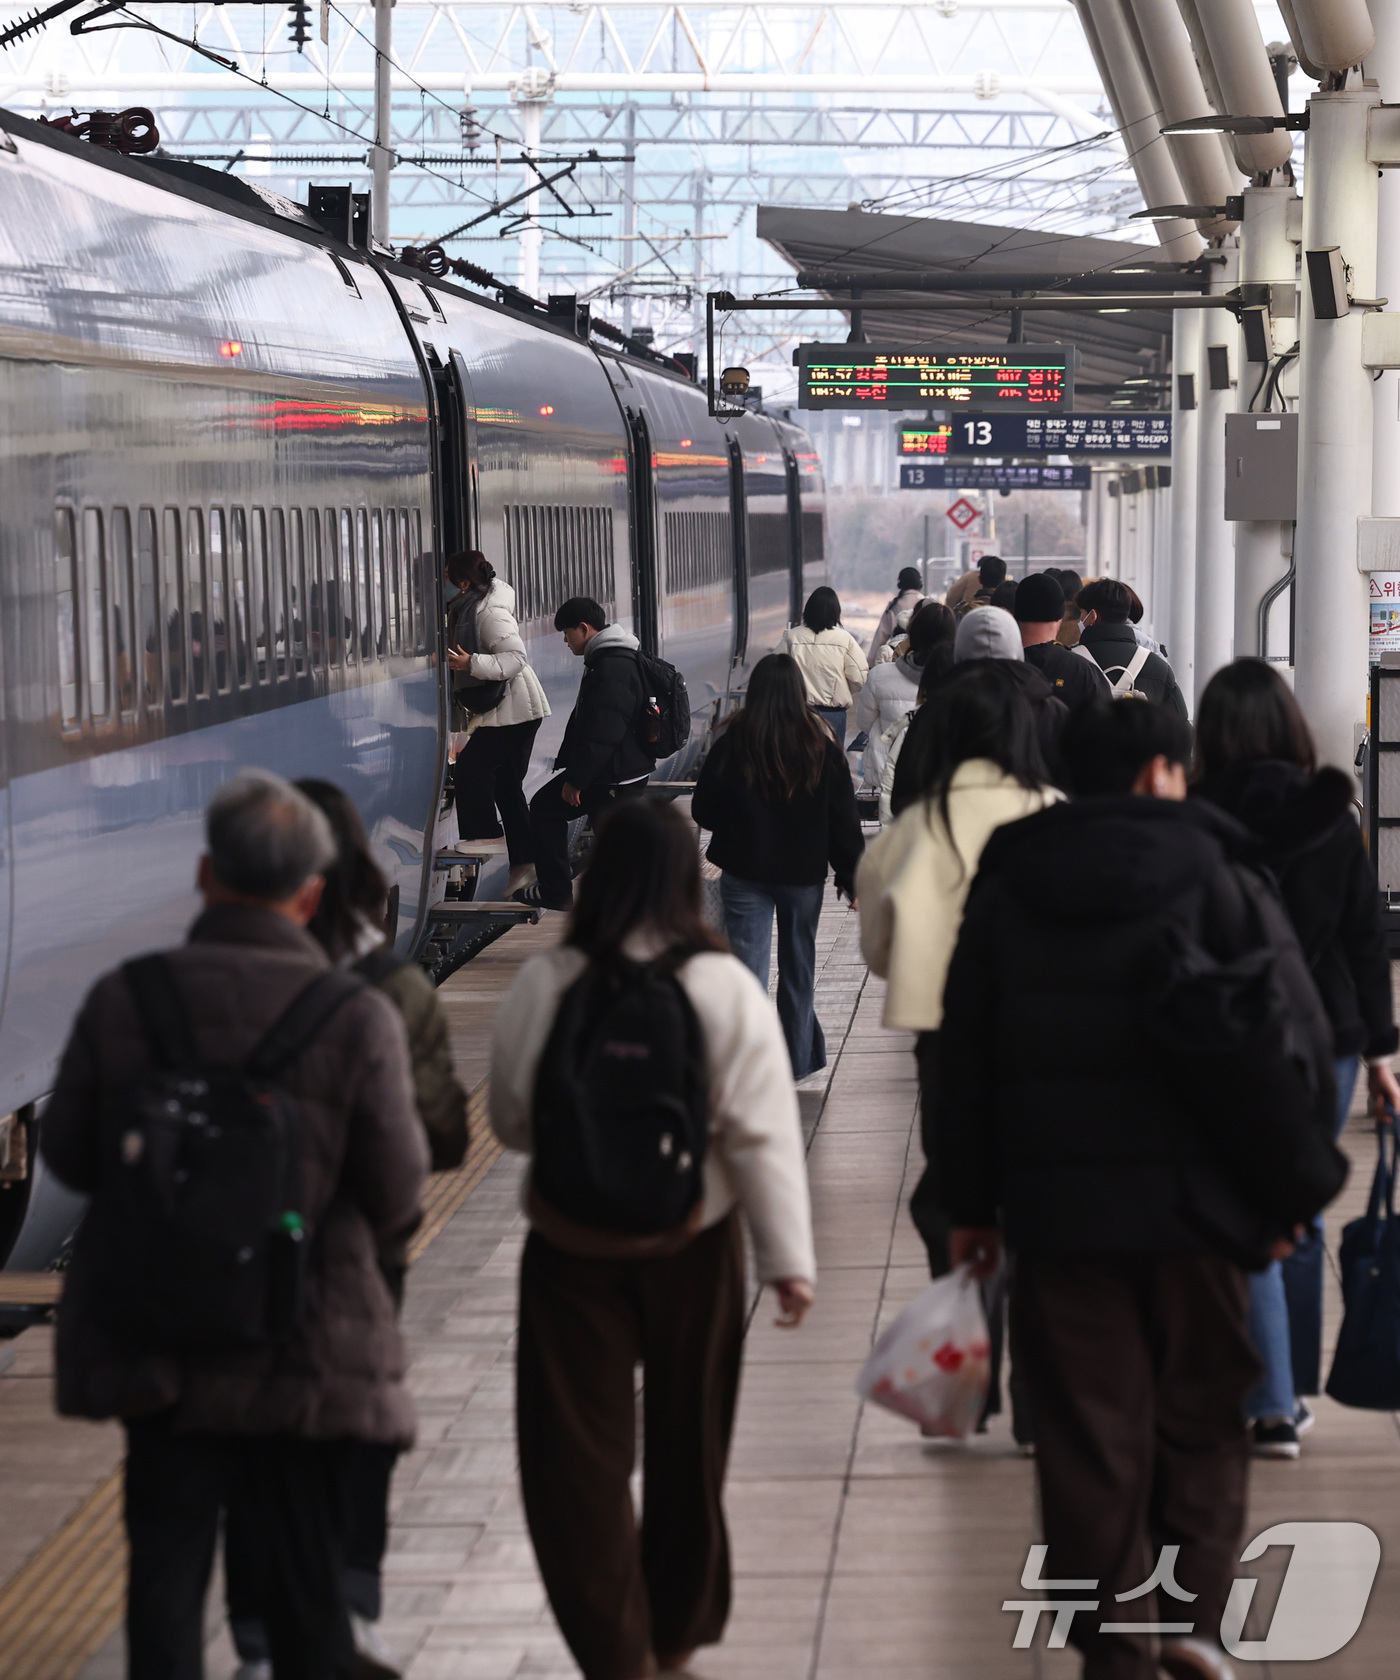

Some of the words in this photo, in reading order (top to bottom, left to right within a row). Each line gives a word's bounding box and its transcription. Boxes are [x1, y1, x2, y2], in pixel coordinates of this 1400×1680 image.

[1046, 419, 1067, 429] 동대구
[1072, 419, 1087, 429] 부산
[1092, 419, 1107, 429] 포항
[963, 421, 993, 445] 13
[1136, 434, 1169, 444] 여수EXPO
[907, 469, 925, 484] 13
